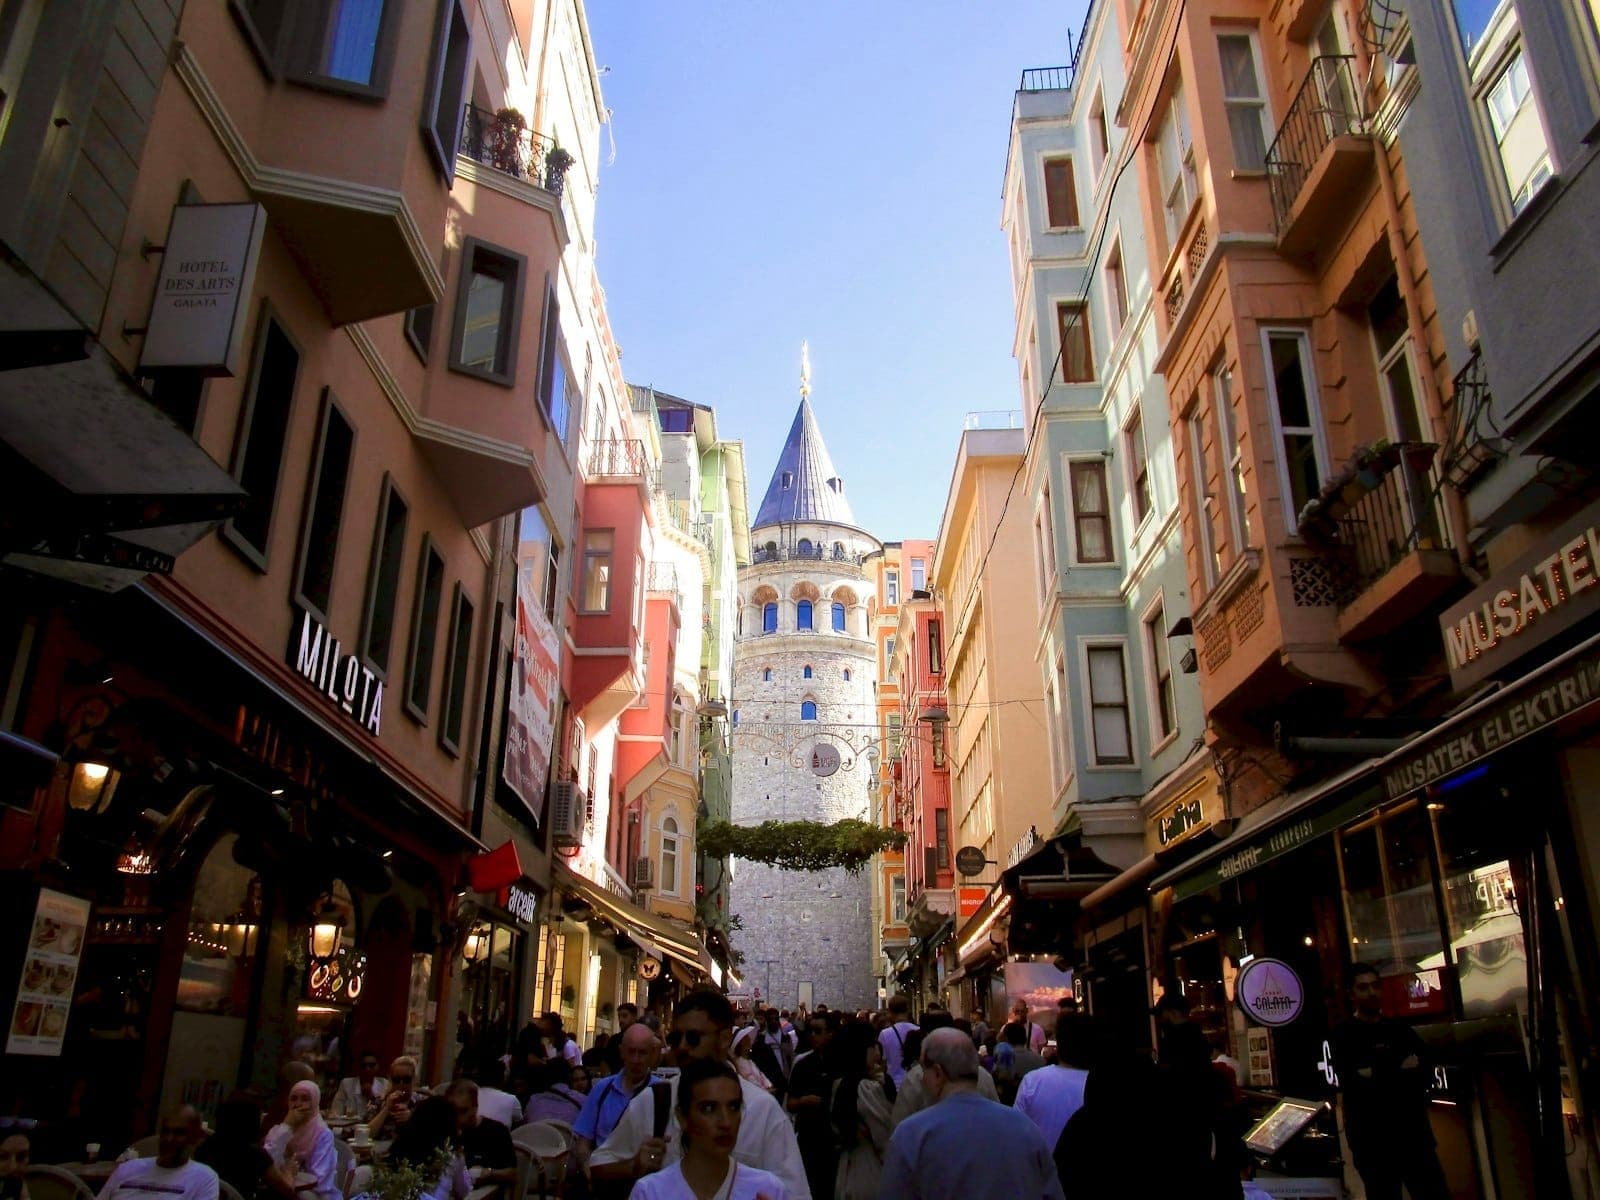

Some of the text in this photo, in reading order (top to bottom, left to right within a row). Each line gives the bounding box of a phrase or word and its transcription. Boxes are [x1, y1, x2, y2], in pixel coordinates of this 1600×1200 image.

[179, 261, 229, 273] HOTEL
[165, 276, 235, 290] DES ARTS
[173, 298, 217, 308] GALATA
[296, 610, 383, 736] MILOTA
[1384, 731, 1480, 799] MUSATEK
[508, 885, 536, 924] arçelik
[1251, 996, 1297, 1010] GALATA
